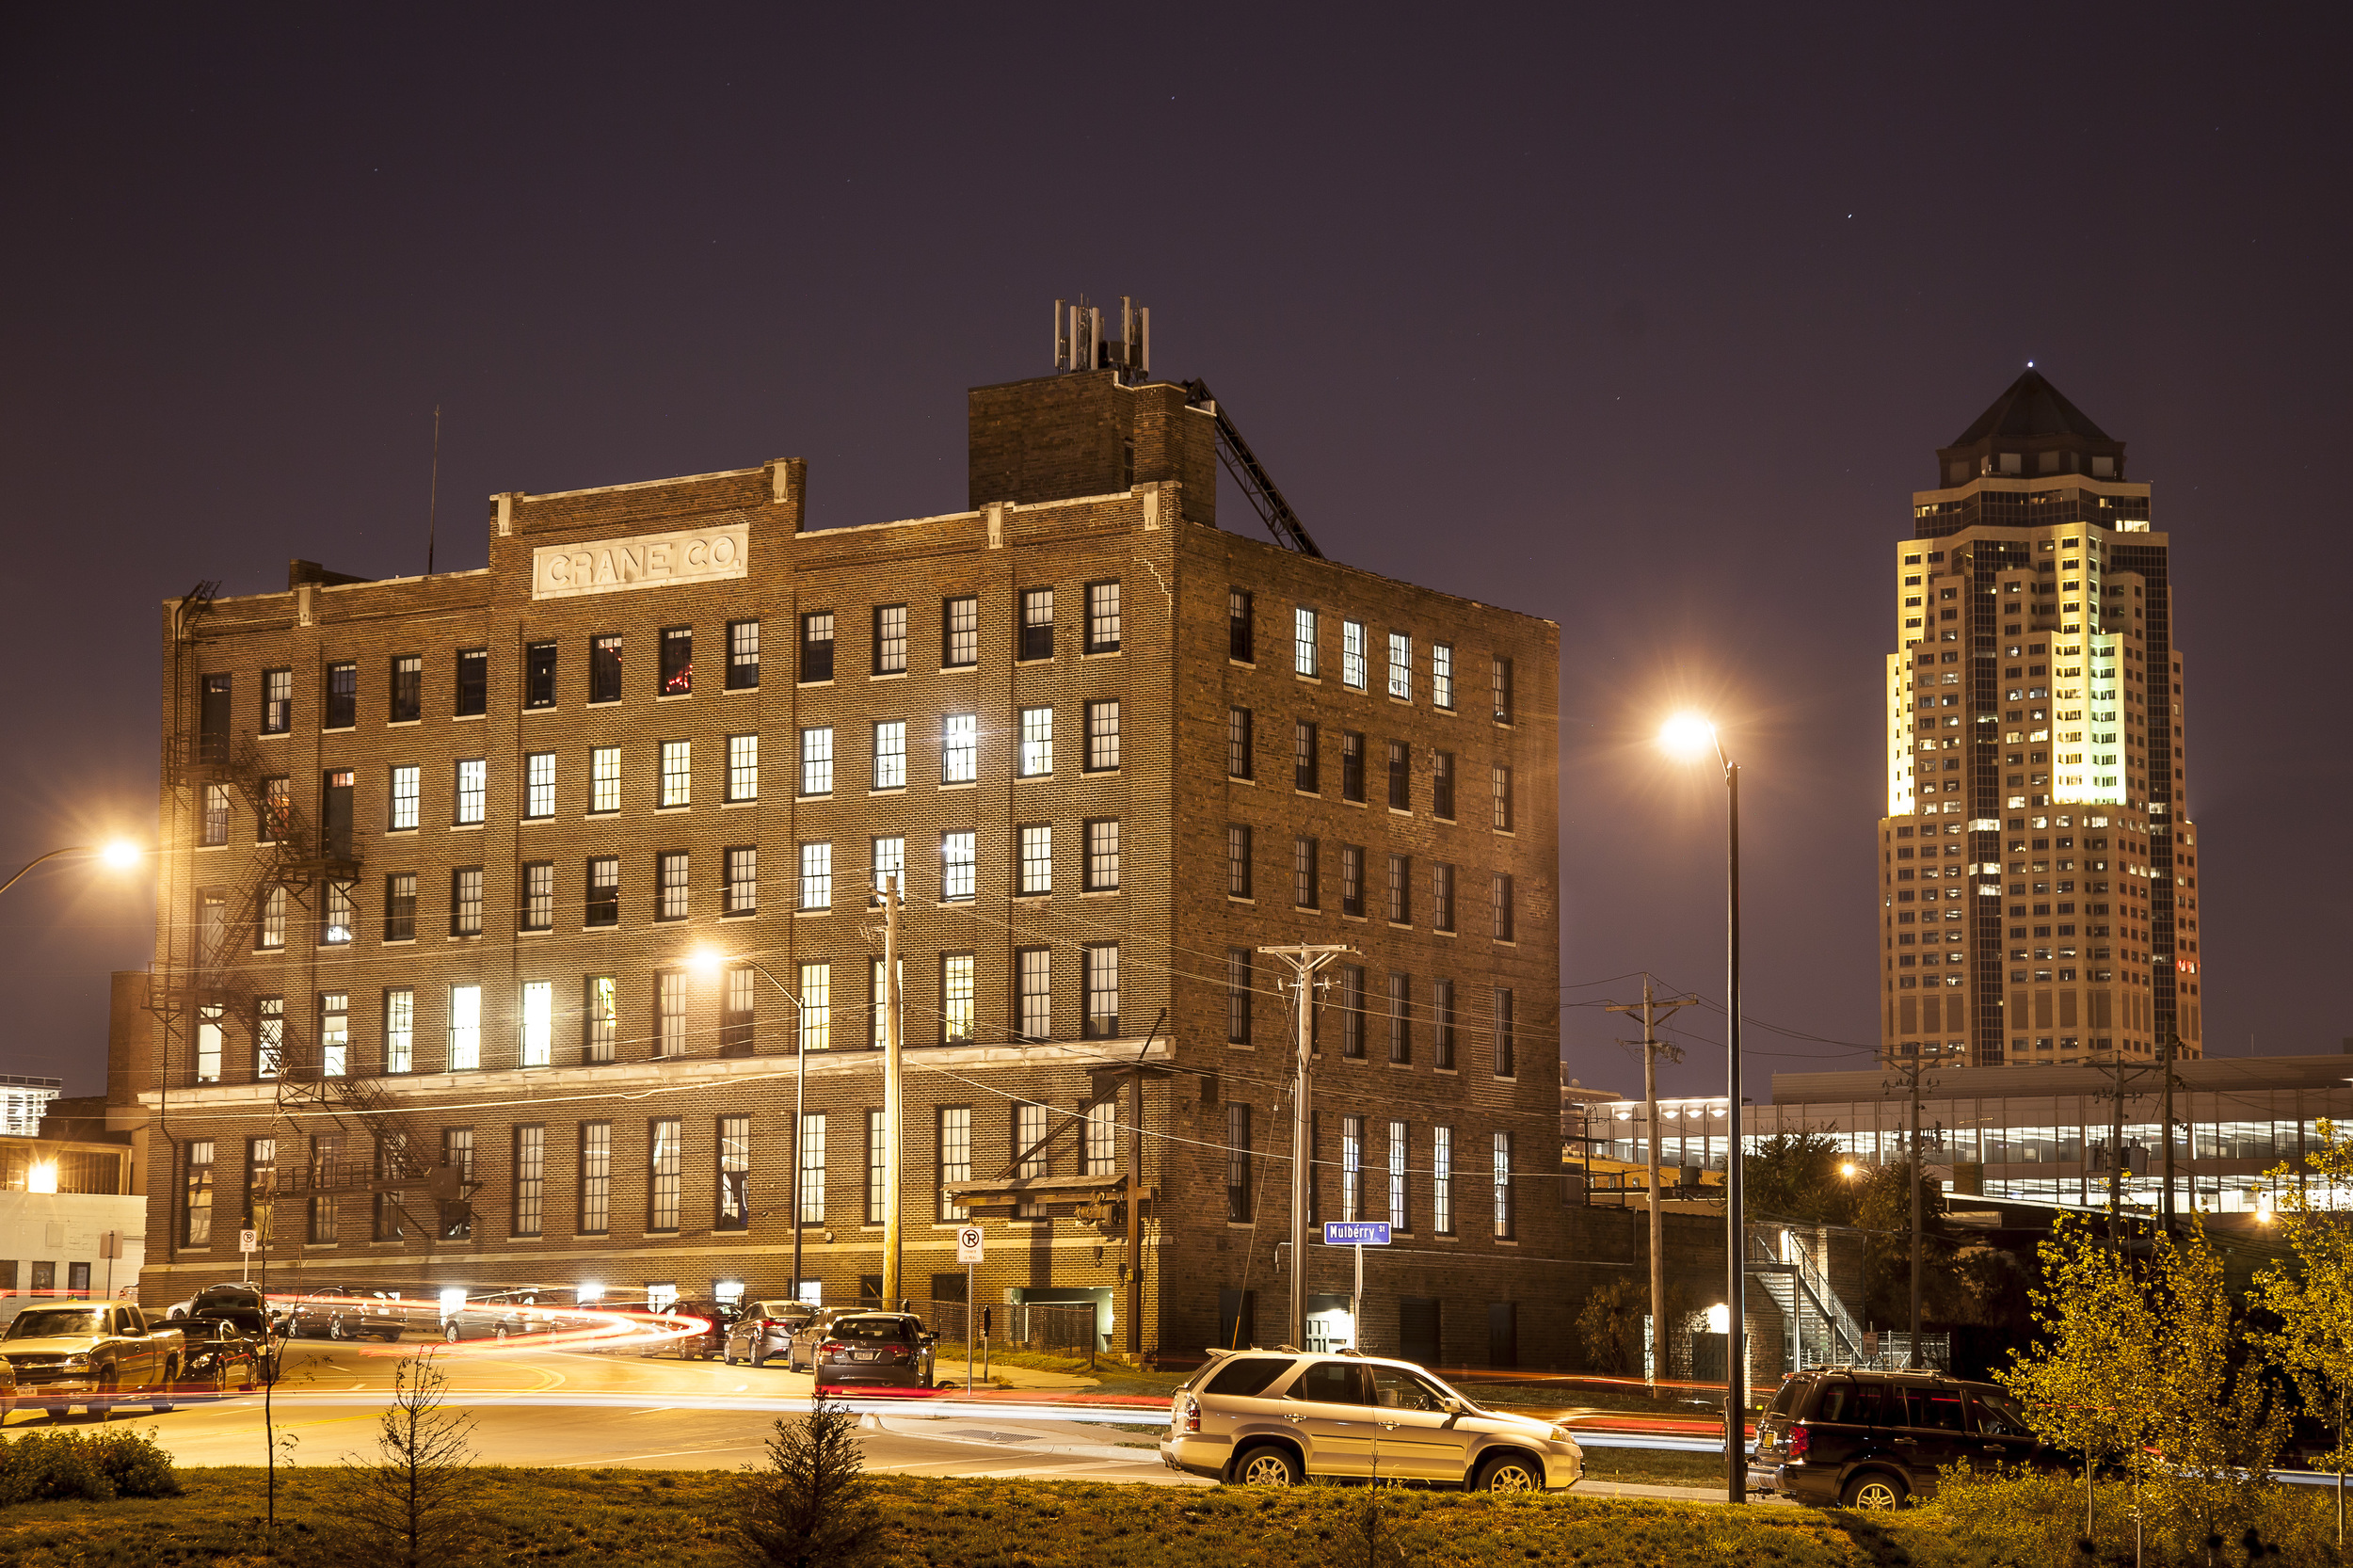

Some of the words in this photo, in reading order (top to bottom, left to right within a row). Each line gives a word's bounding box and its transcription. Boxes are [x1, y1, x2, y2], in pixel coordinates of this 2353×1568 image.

[547, 543, 674, 585] CRANE
[683, 536, 742, 571] CO.
[1329, 1224, 1375, 1241] Mulberry
[1378, 1224, 1385, 1233] St
